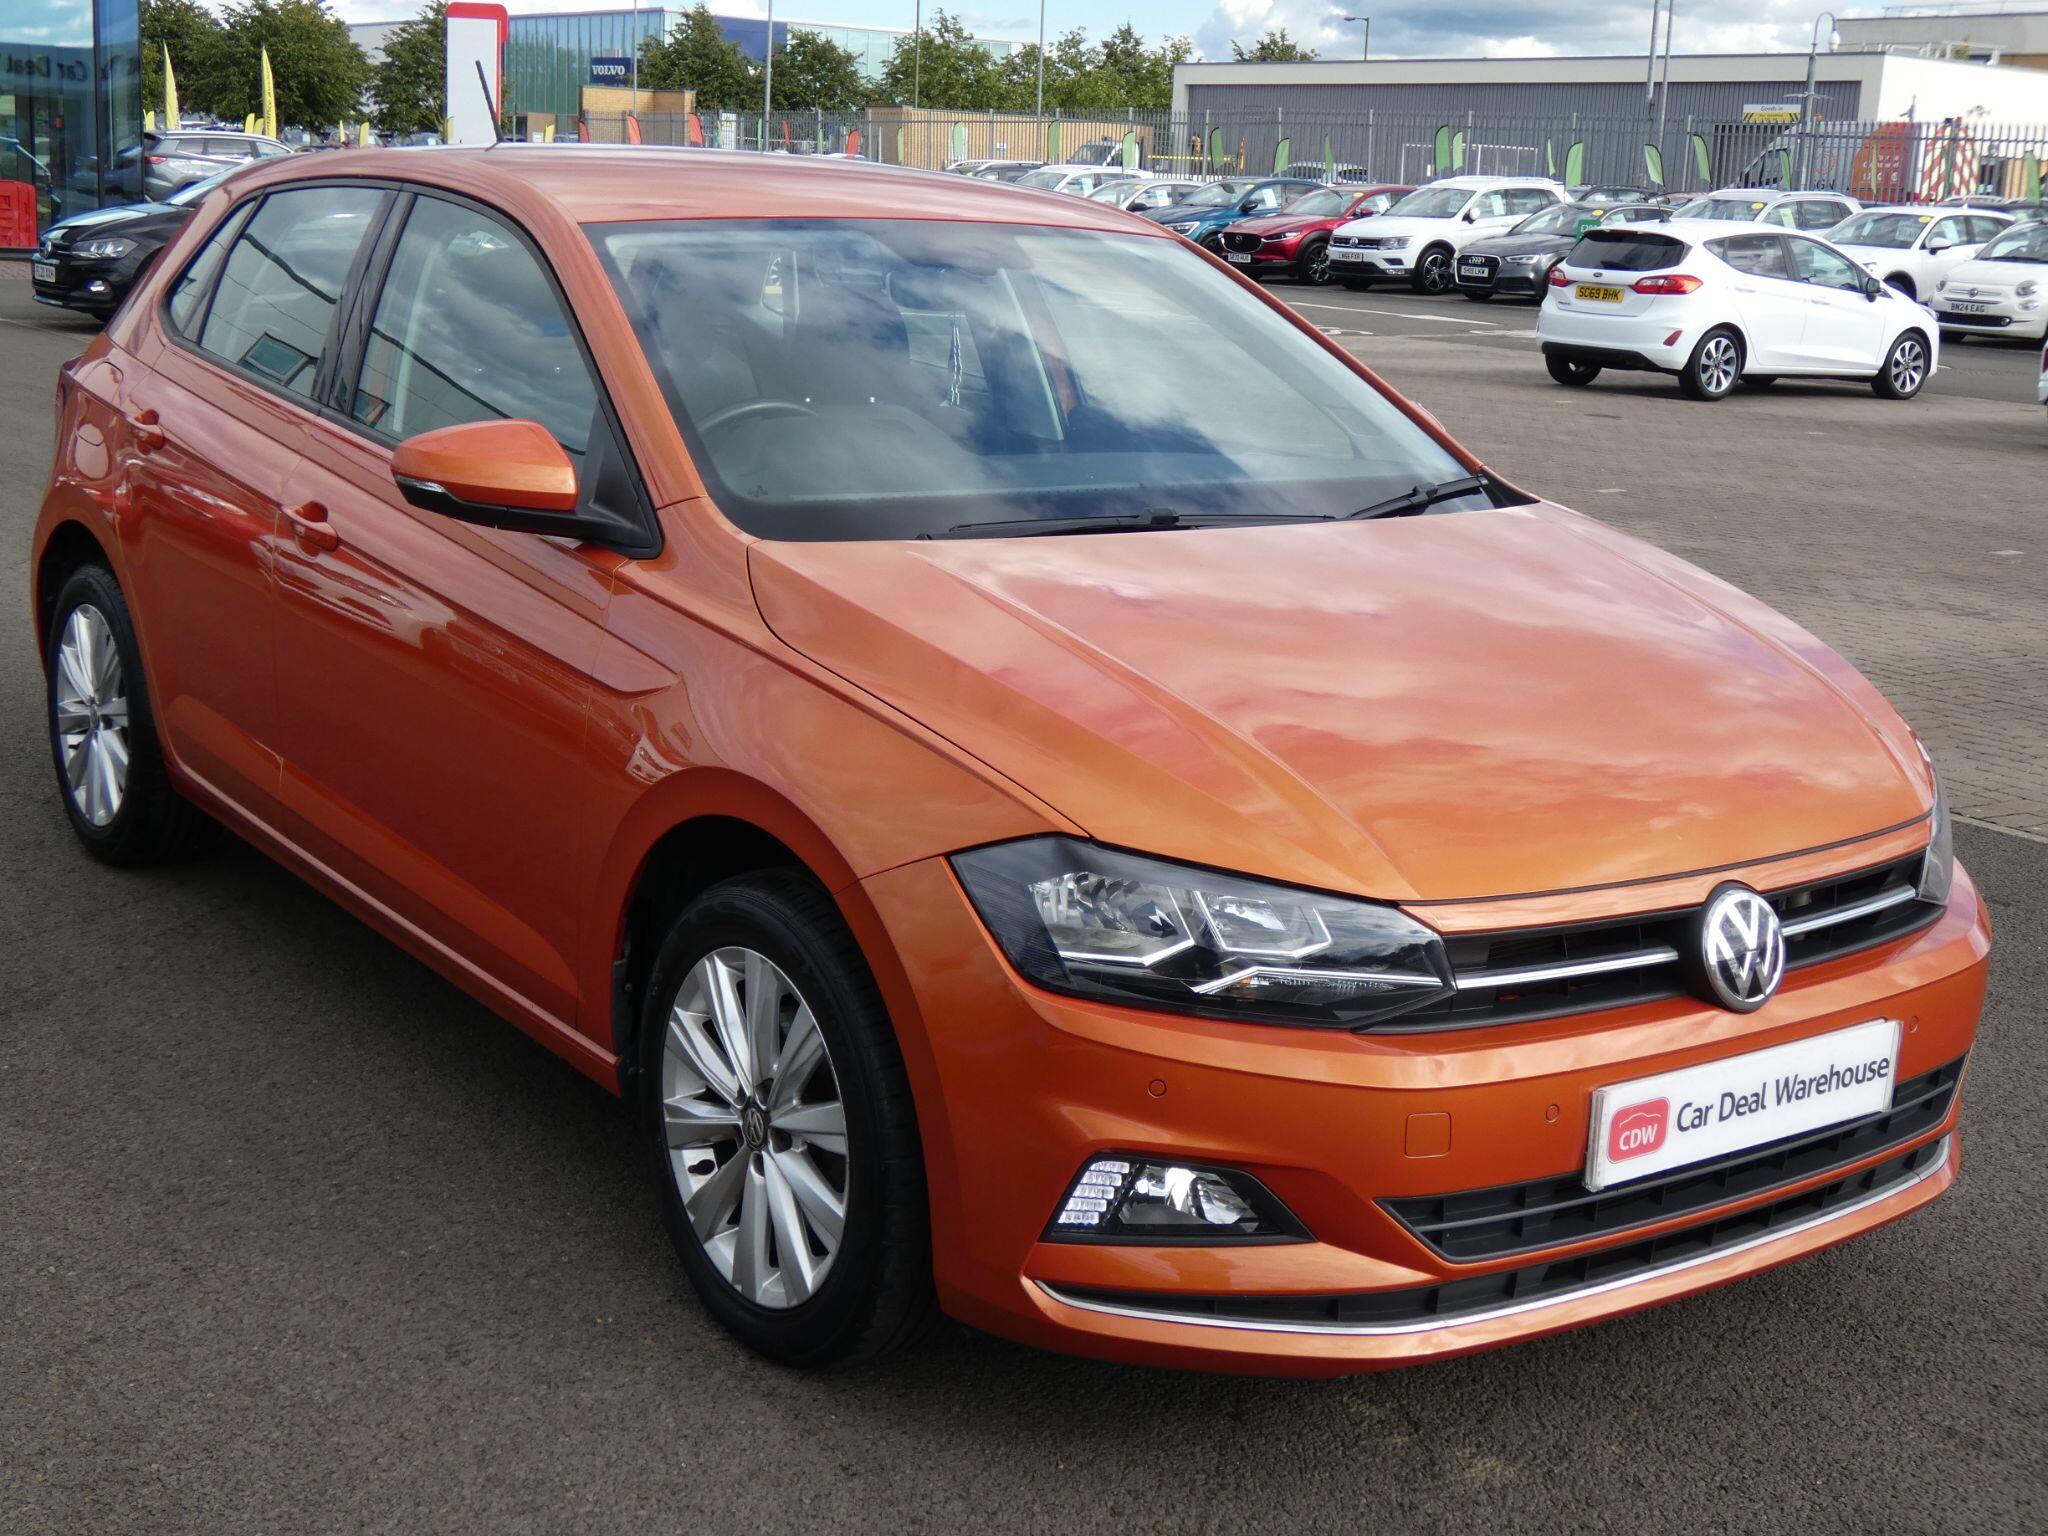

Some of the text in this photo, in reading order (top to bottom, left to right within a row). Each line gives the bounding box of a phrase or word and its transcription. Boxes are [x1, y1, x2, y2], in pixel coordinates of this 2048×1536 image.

[591, 65, 625, 75] VOLVO
[1475, 267, 1487, 276] LKW
[1602, 289, 1621, 301] BHK
[1950, 302, 1986, 313] BN24 EAG
[1676, 1057, 1890, 1133] Car Deal Warehouse
[1618, 1123, 1658, 1151] CDW
